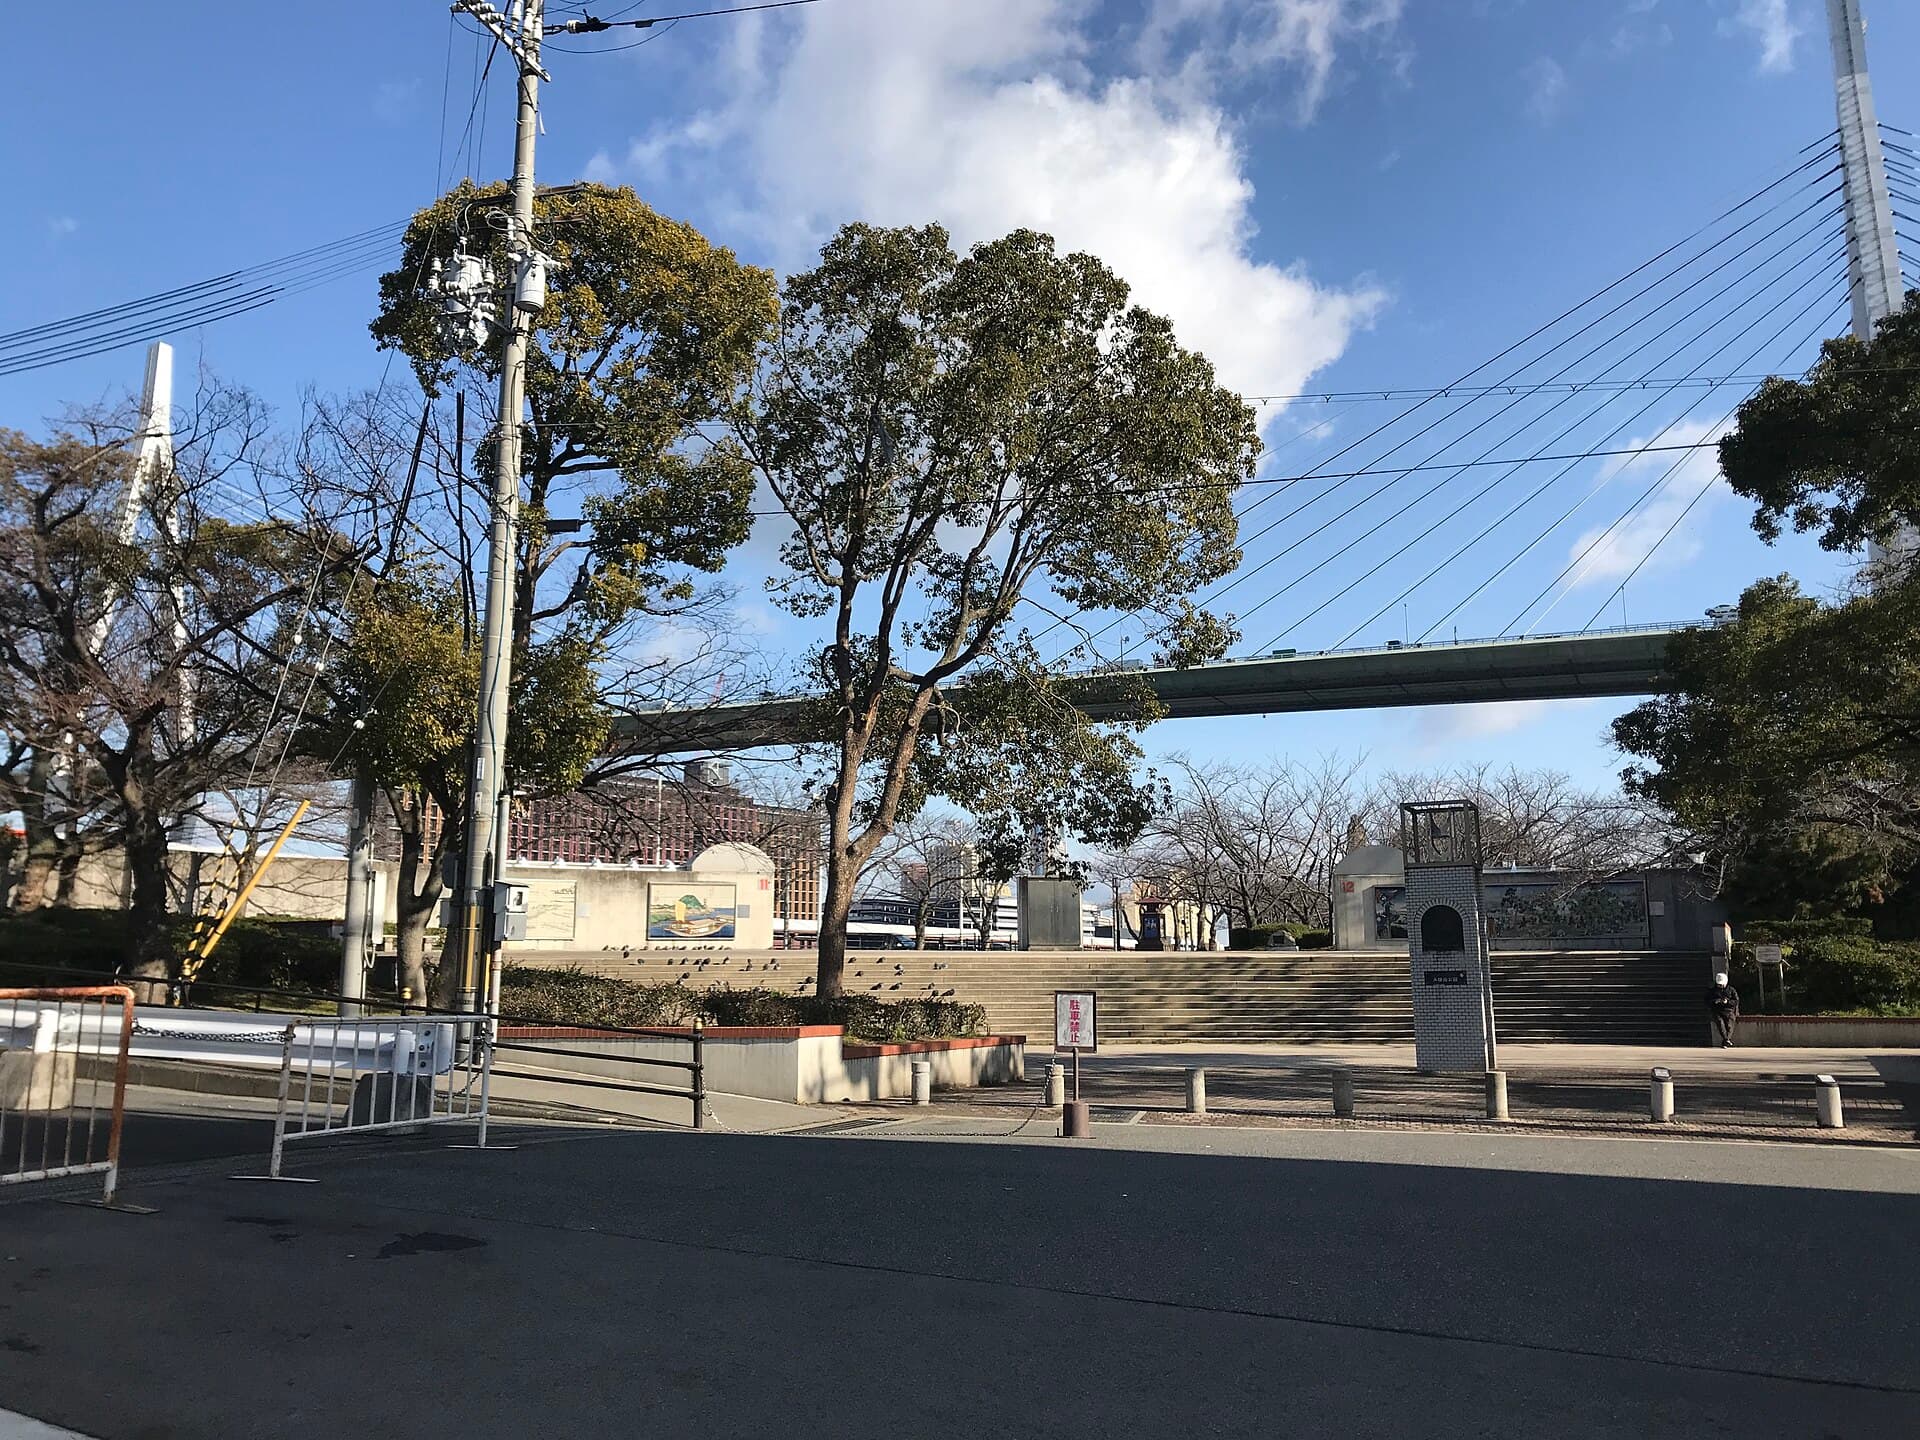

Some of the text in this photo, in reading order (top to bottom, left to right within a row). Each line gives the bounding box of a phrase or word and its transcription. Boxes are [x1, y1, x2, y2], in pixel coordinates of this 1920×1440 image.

[1342, 881, 1354, 892] 12
[1069, 999, 1080, 1043] 駐車禁止
